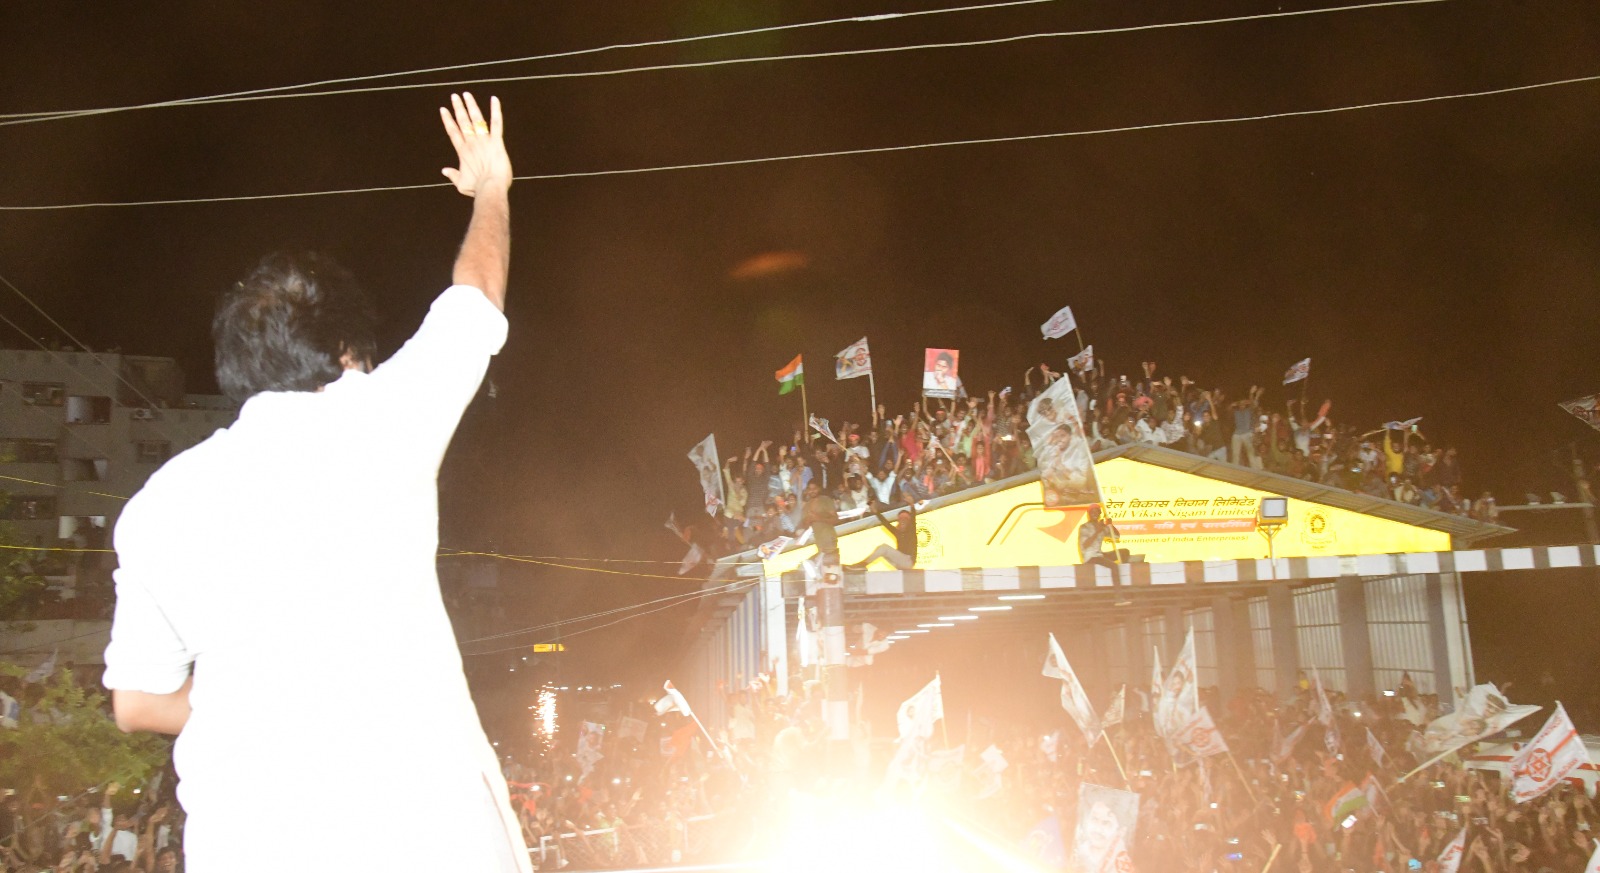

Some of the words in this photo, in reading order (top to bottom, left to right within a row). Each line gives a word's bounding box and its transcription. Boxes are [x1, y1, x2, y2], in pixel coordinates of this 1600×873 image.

[1128, 498, 1170, 508] विकास
[1173, 497, 1209, 507] निगम
[1213, 496, 1256, 506] लिमिटेड
[1131, 510, 1162, 518] Vikas
[1168, 510, 1206, 518] Nigam
[1211, 508, 1255, 516] Limited
